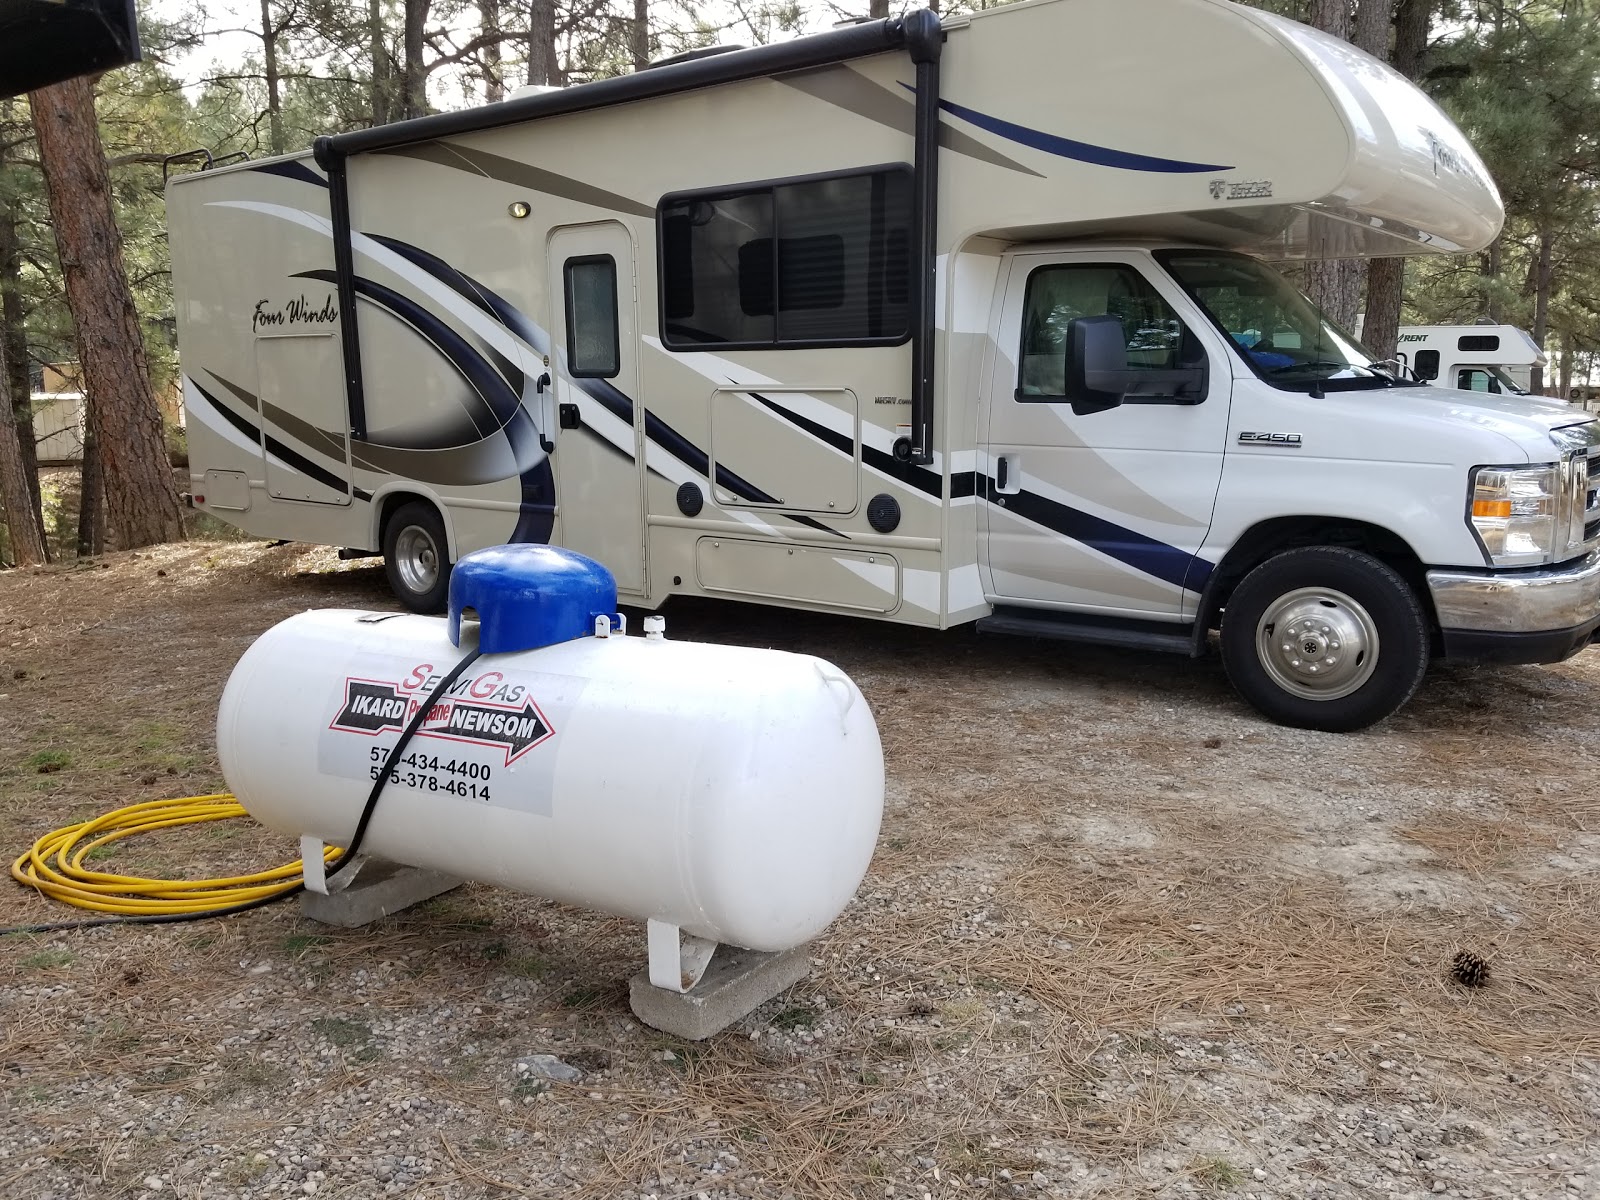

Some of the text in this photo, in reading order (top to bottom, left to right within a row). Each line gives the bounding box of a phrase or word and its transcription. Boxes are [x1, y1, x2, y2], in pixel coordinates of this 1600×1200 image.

[252, 293, 339, 334] Four Winds
[1239, 431, 1302, 443] E-450
[402, 663, 526, 703] SEVIGAS
[350, 694, 537, 740] IKARD Prpane NEWSOM
[369, 746, 491, 781] 57-434-4400
[369, 766, 491, 802] 55-378-4614
